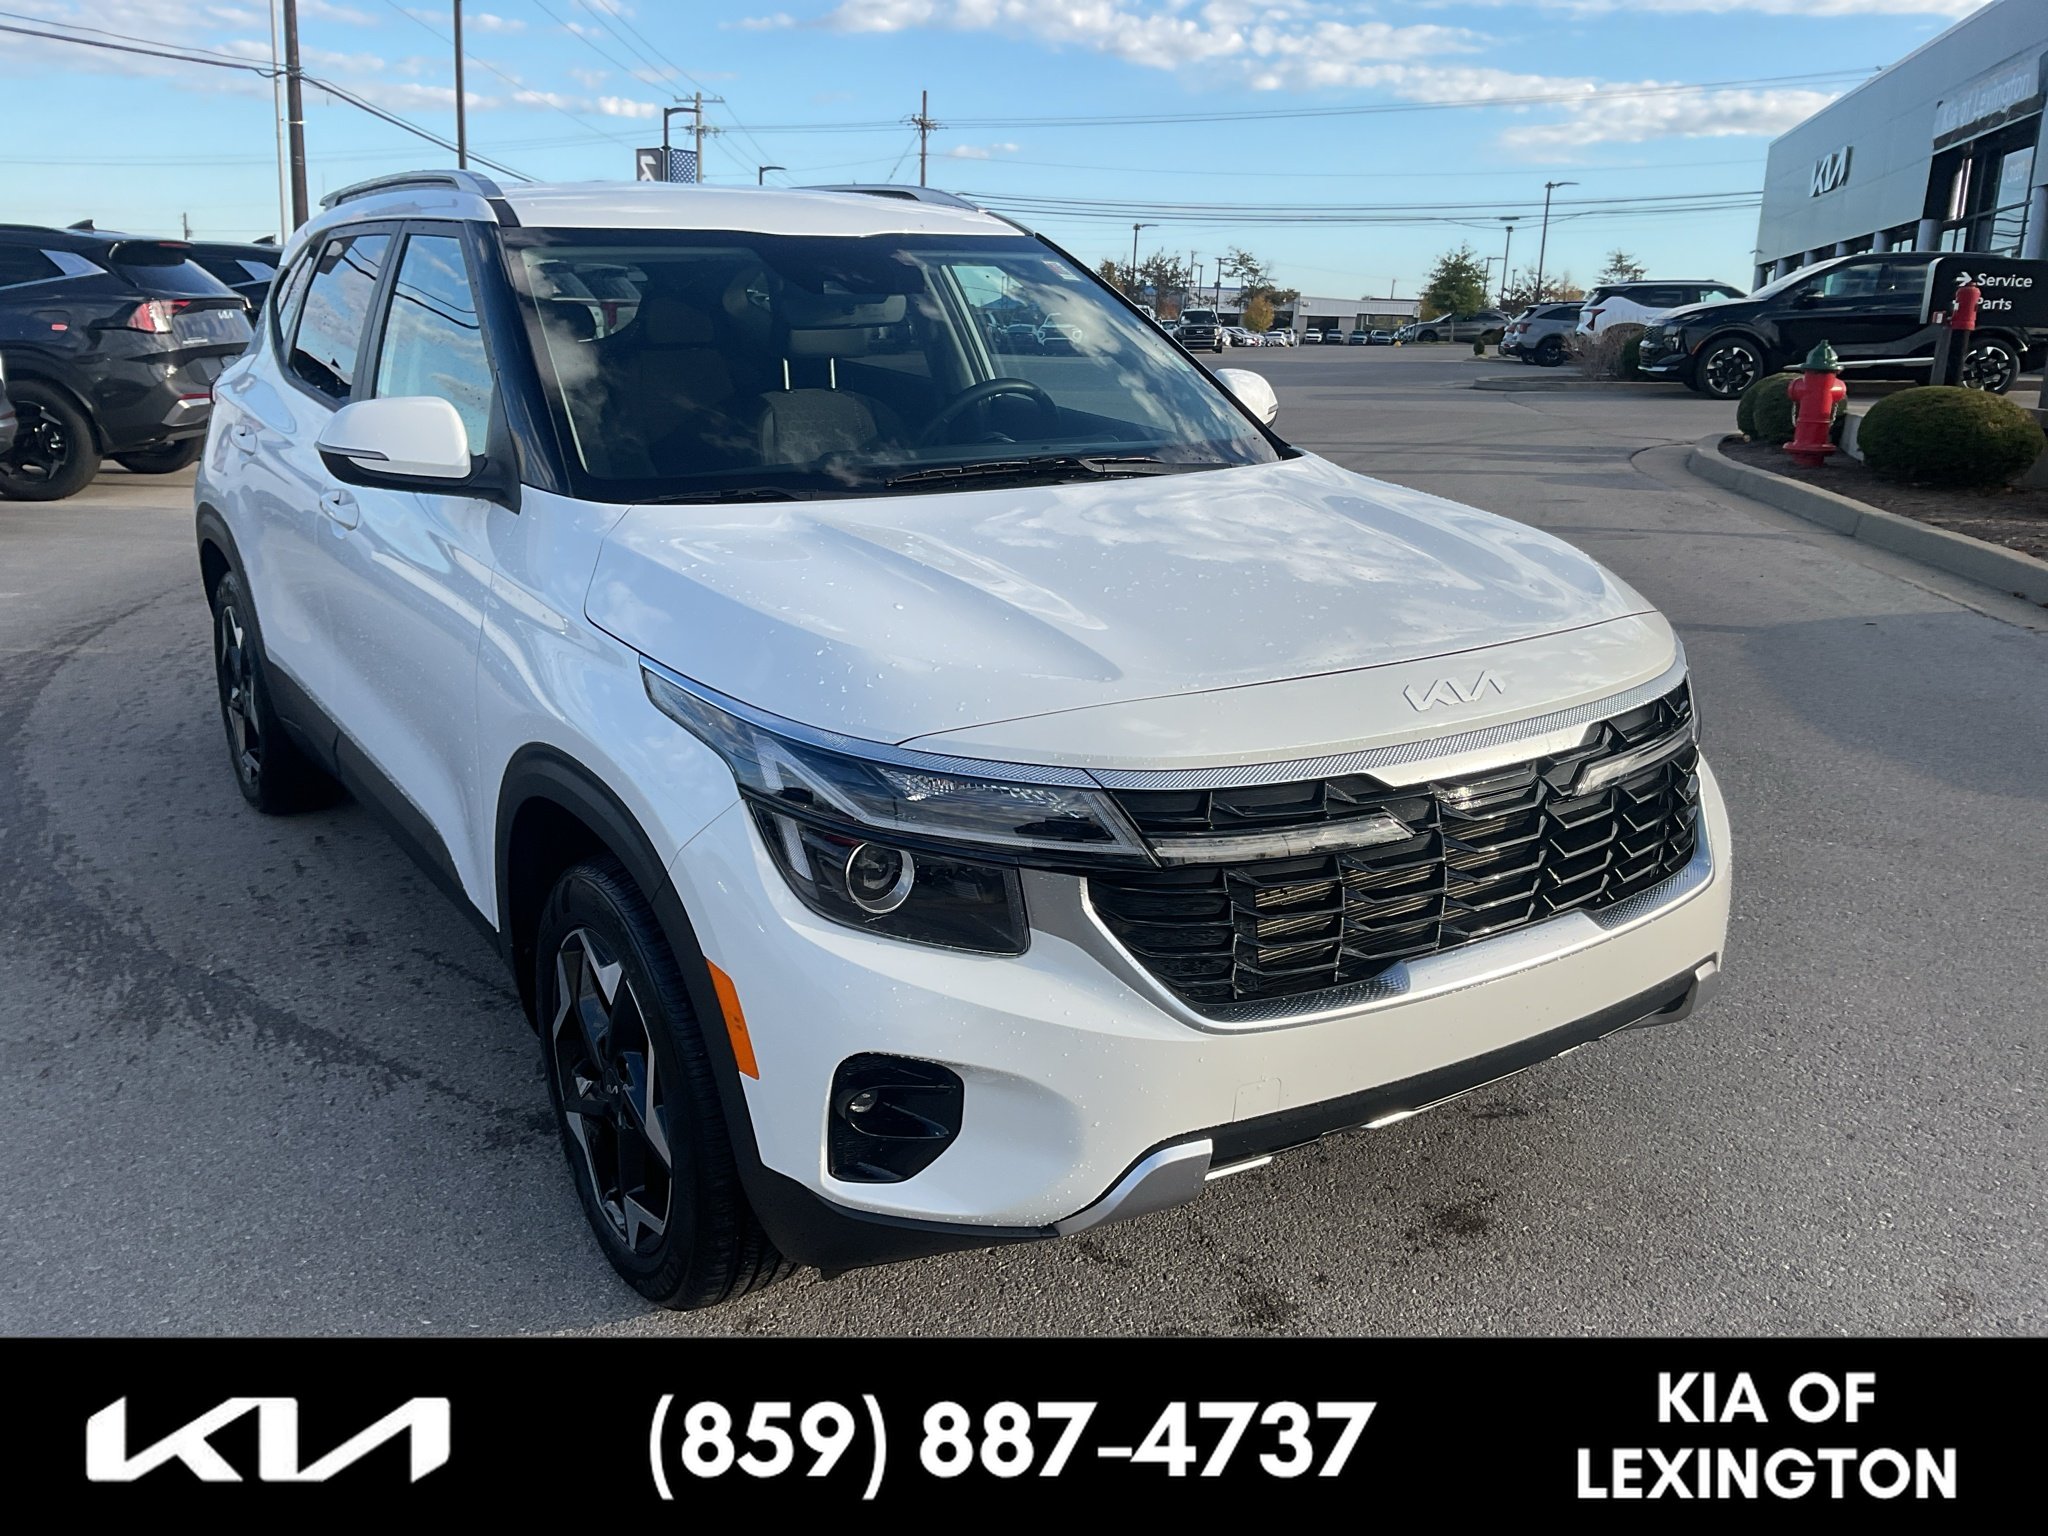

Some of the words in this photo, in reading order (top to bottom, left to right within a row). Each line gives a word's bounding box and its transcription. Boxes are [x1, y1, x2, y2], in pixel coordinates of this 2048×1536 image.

[1808, 146, 1850, 197] KIA
[1977, 273, 2033, 288] Service
[1977, 297, 2012, 310] Parts
[1403, 669, 1507, 712] KIA
